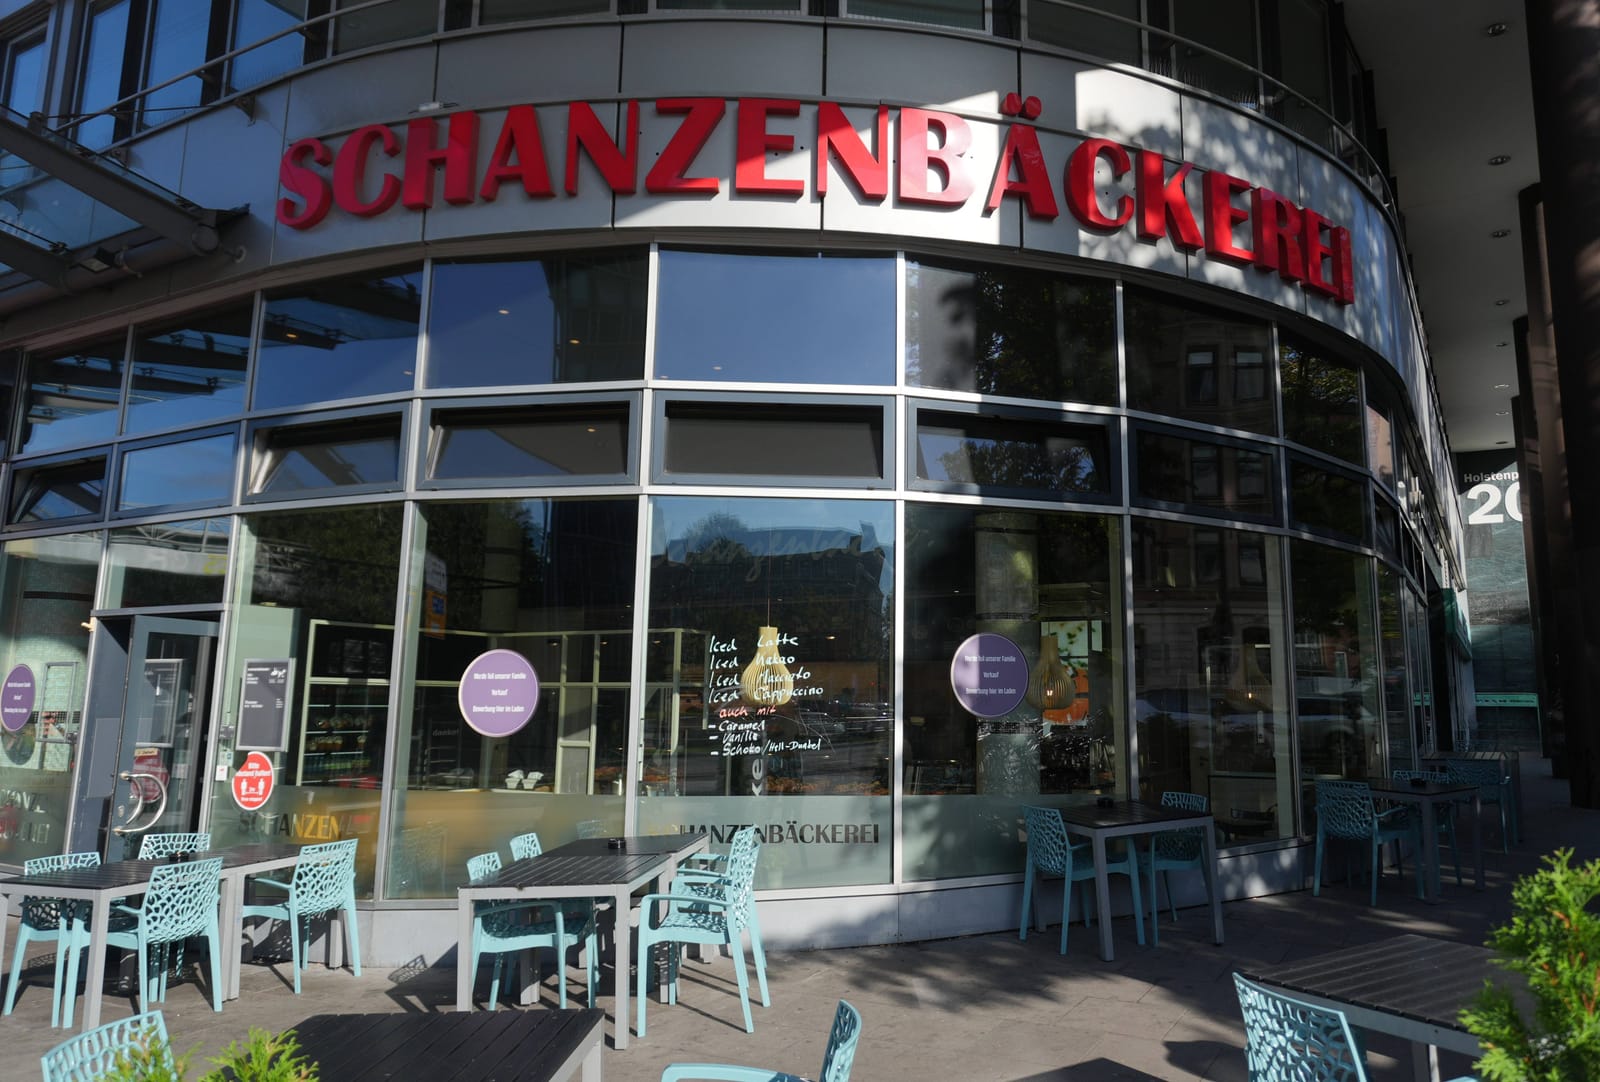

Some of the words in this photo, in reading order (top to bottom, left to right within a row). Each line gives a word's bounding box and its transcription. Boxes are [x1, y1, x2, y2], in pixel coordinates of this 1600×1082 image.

[276, 92, 1354, 304] SCHANZENBÄCKEREI
[709, 635, 738, 653] Iced
[757, 632, 799, 648] Latte
[710, 654, 739, 670] Iced
[709, 670, 740, 688] Iced
[708, 687, 740, 704] Iced
[719, 706, 749, 719] auch
[757, 704, 777, 715] mit
